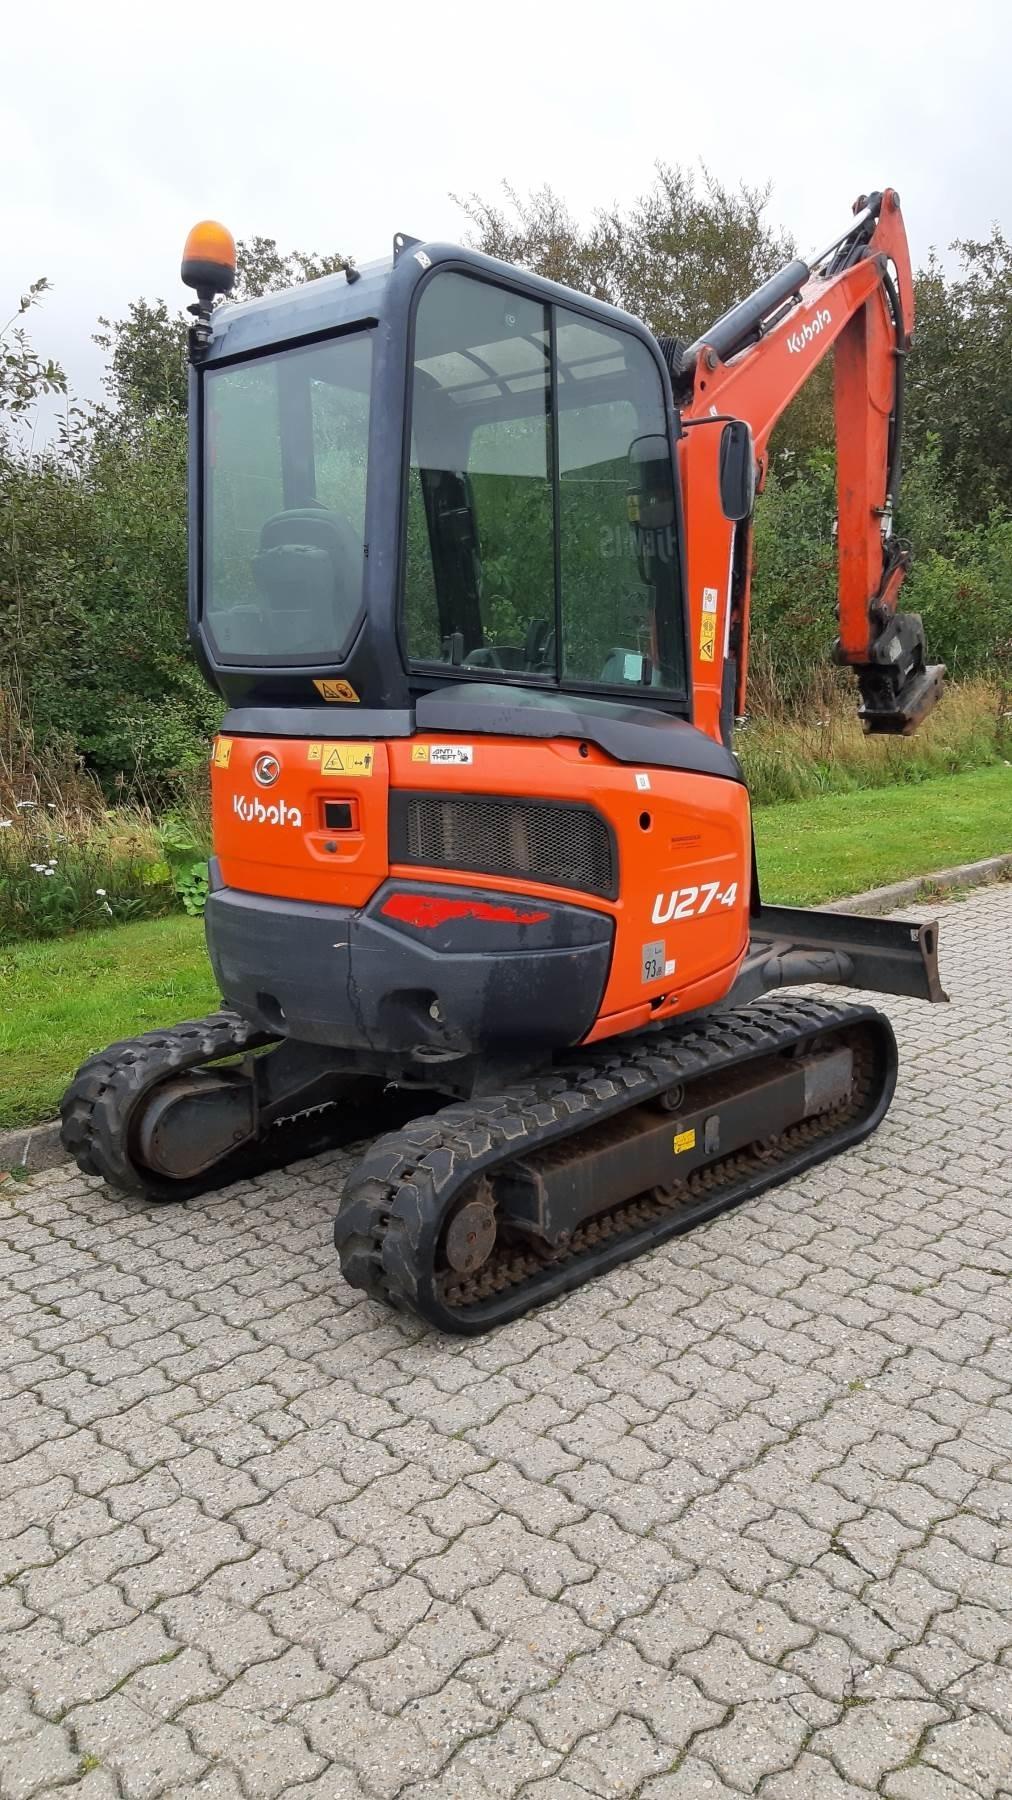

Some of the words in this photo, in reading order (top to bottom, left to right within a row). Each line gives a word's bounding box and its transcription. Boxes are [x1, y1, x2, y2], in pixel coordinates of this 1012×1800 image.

[787, 309, 832, 353] Kubota
[233, 795, 302, 827] Kubota
[651, 881, 738, 925] U27-4
[644, 959, 657, 979] 93
